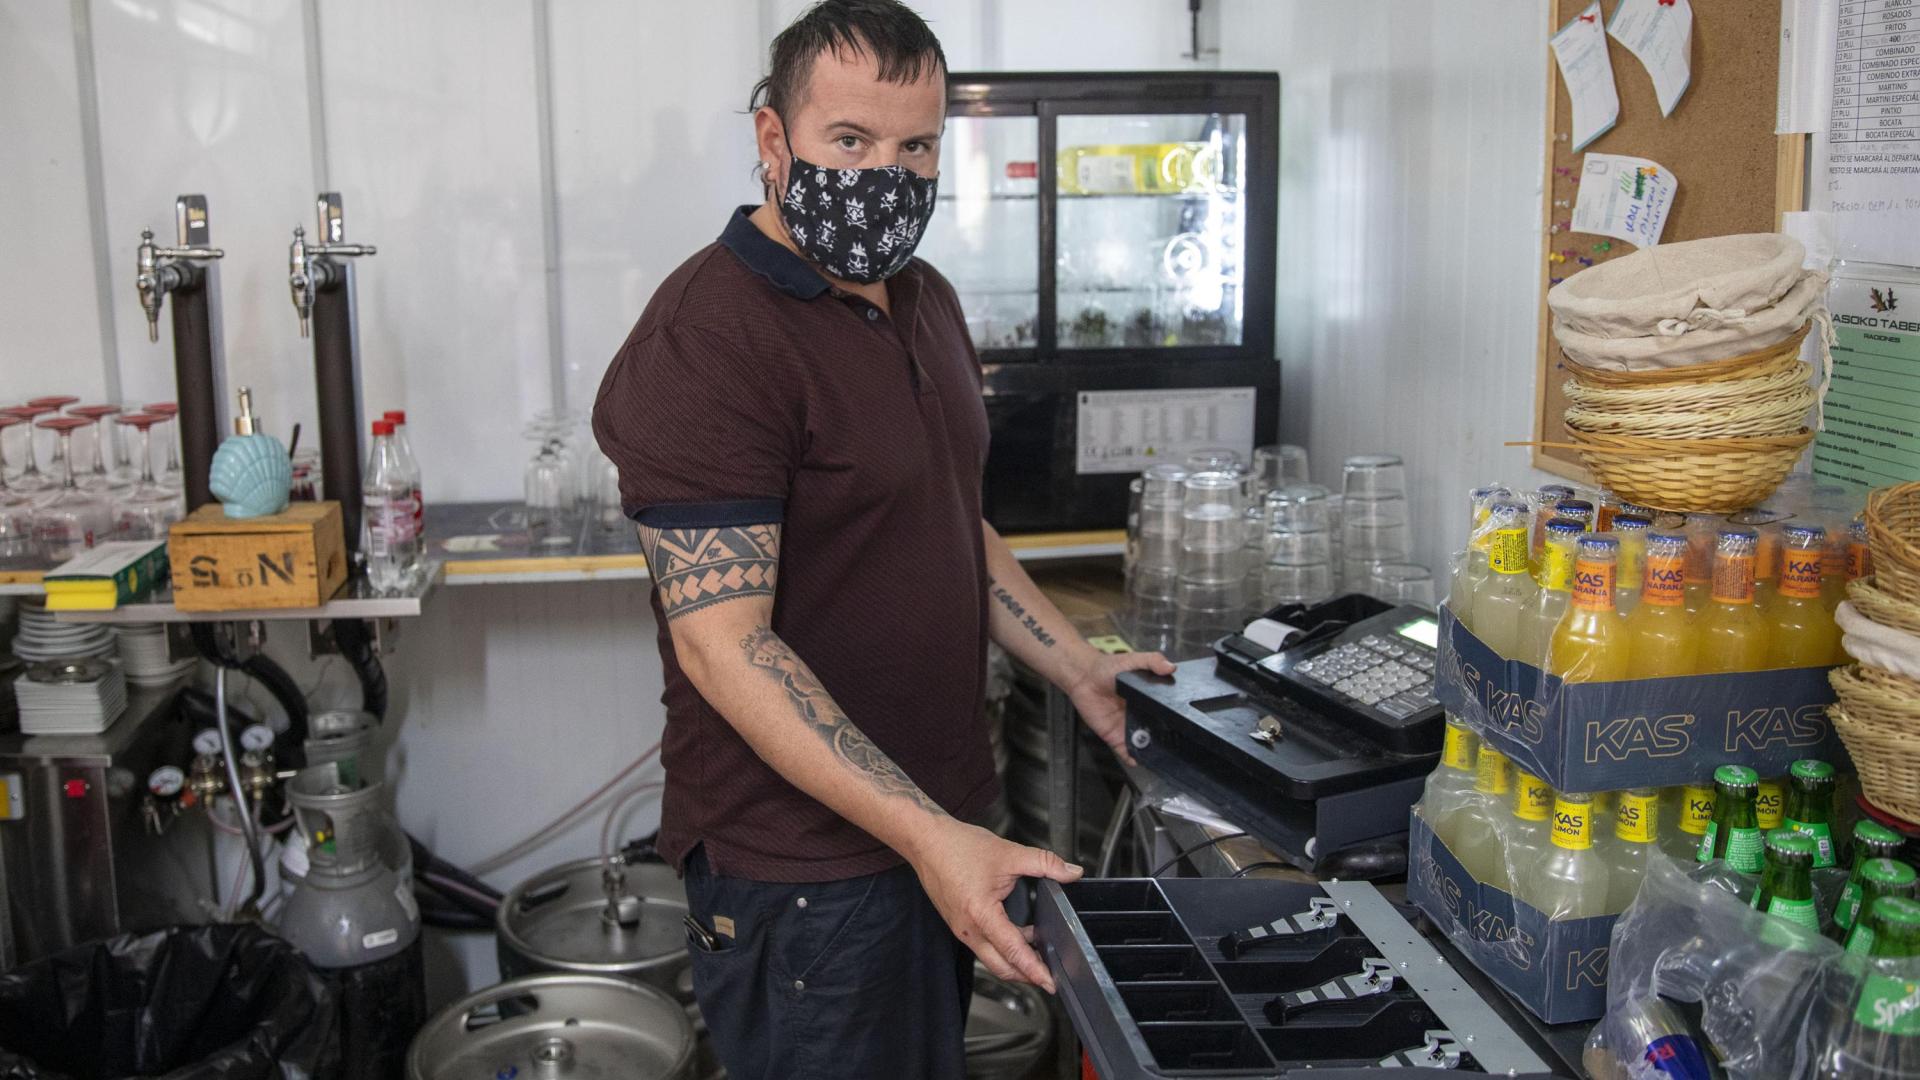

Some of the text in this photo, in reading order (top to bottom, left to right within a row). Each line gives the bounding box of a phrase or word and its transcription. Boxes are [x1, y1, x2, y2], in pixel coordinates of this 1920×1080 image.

[1882, 10, 1912, 20] ROSADOS
[1885, 22, 1907, 31] FRITOS
[1876, 46, 1916, 57] COMBINADO
[1862, 60, 1899, 70] COMBINADO
[1901, 57, 1920, 66] ESPEC
[1878, 83, 1908, 91] MARTINIS
[1866, 95, 1890, 104] MARTINI
[1880, 118, 1902, 127] BOCATA
[1866, 131, 1888, 139] BOCATA
[1831, 313, 1877, 327] ASOKO
[1863, 333, 1901, 343] RACIONES
[1789, 560, 1822, 574] KAS
[1574, 570, 1605, 588] KAS
[1651, 567, 1684, 583] KAS
[1783, 573, 1822, 584] NARANJ
[1573, 584, 1608, 598] ARANJA
[1646, 581, 1684, 592] NARANJ
[1486, 680, 1547, 745] KAS
[1725, 704, 1830, 752] KAS
[1584, 714, 1694, 764] KAS
[1528, 786, 1551, 800] KA
[1690, 799, 1713, 813] KA
[1757, 806, 1778, 816] MÓN
[1553, 811, 1584, 828] KAS
[1553, 823, 1581, 837] LIMÓN
[1468, 900, 1534, 971] KAS
